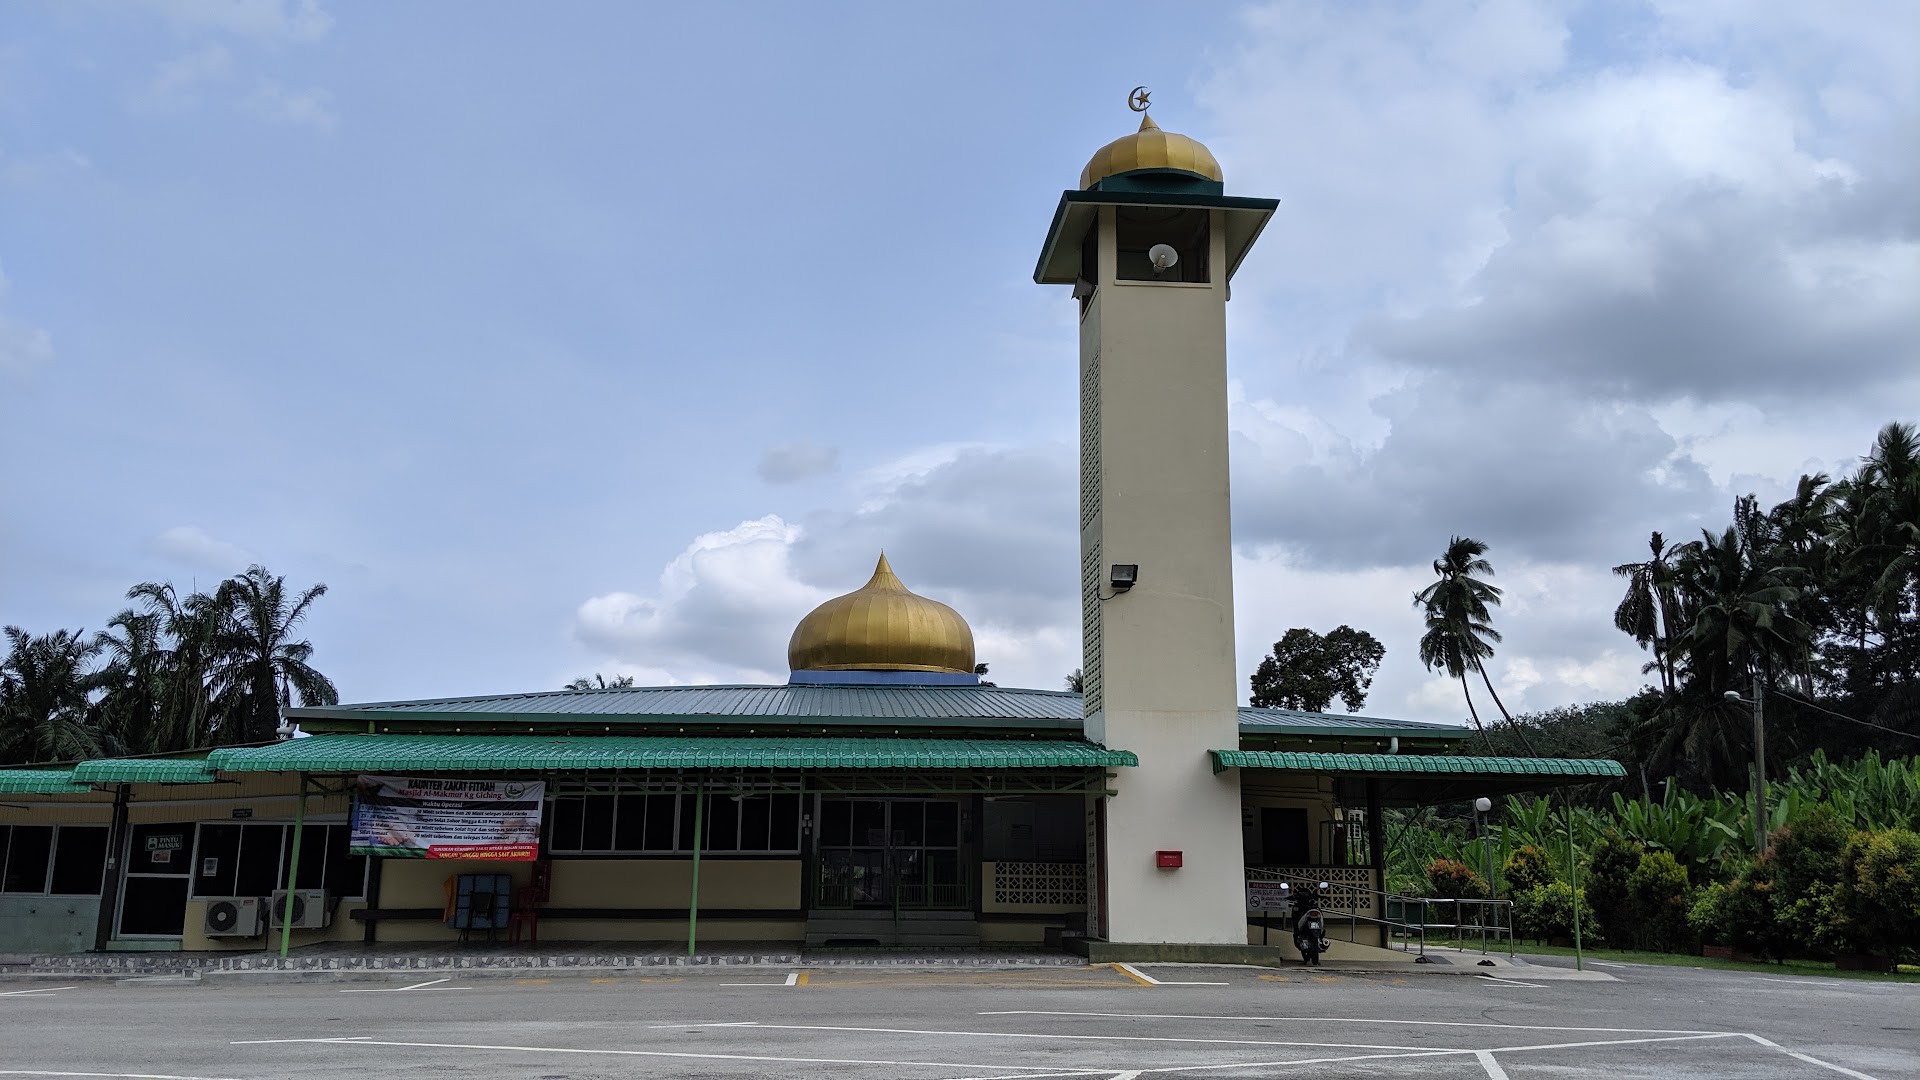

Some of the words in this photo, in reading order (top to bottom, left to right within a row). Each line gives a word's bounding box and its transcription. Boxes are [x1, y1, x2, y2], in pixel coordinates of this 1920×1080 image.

[408, 779, 442, 790] KAUNTER
[444, 781, 468, 791] ZAKAT
[468, 782, 495, 792] FITRAH
[398, 789, 422, 798] Masjid
[464, 791, 474, 800] Kg
[476, 791, 502, 800] Giching
